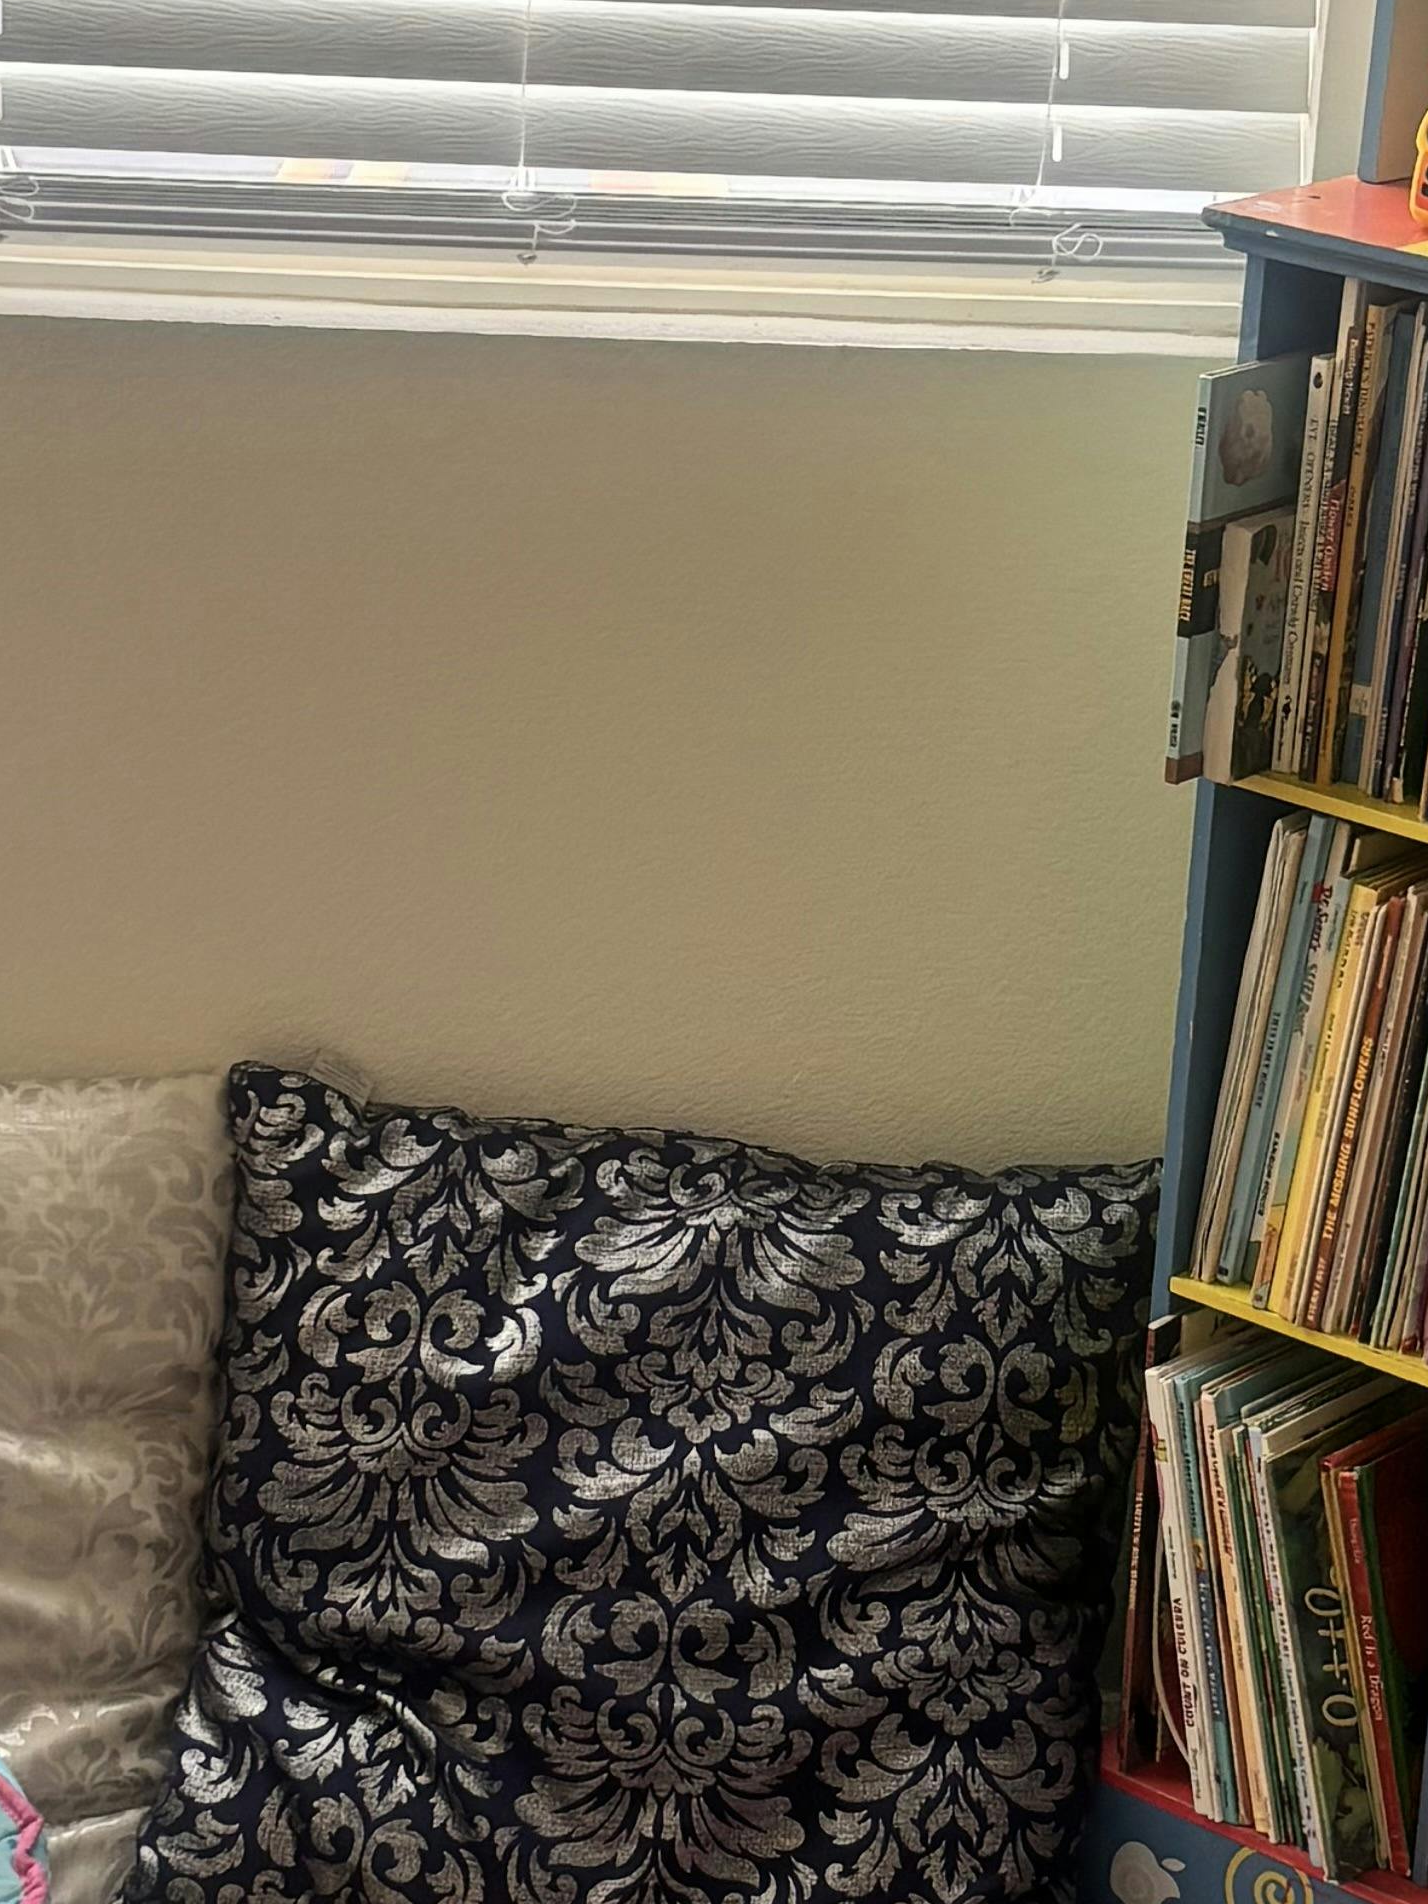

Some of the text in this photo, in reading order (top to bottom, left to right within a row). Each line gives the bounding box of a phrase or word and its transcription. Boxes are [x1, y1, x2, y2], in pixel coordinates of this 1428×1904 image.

[1325, 499, 1340, 541] Flower
[1293, 558, 1306, 582] and
[1319, 545, 1336, 591] Garden
[1319, 1035, 1374, 1241] THE MISSING SUNFLOWERS
[1360, 1614, 1375, 1639] Red
[1172, 1596, 1195, 1728] COUNT ON CULEBRA
[1367, 1674, 1386, 1721] Dragon
